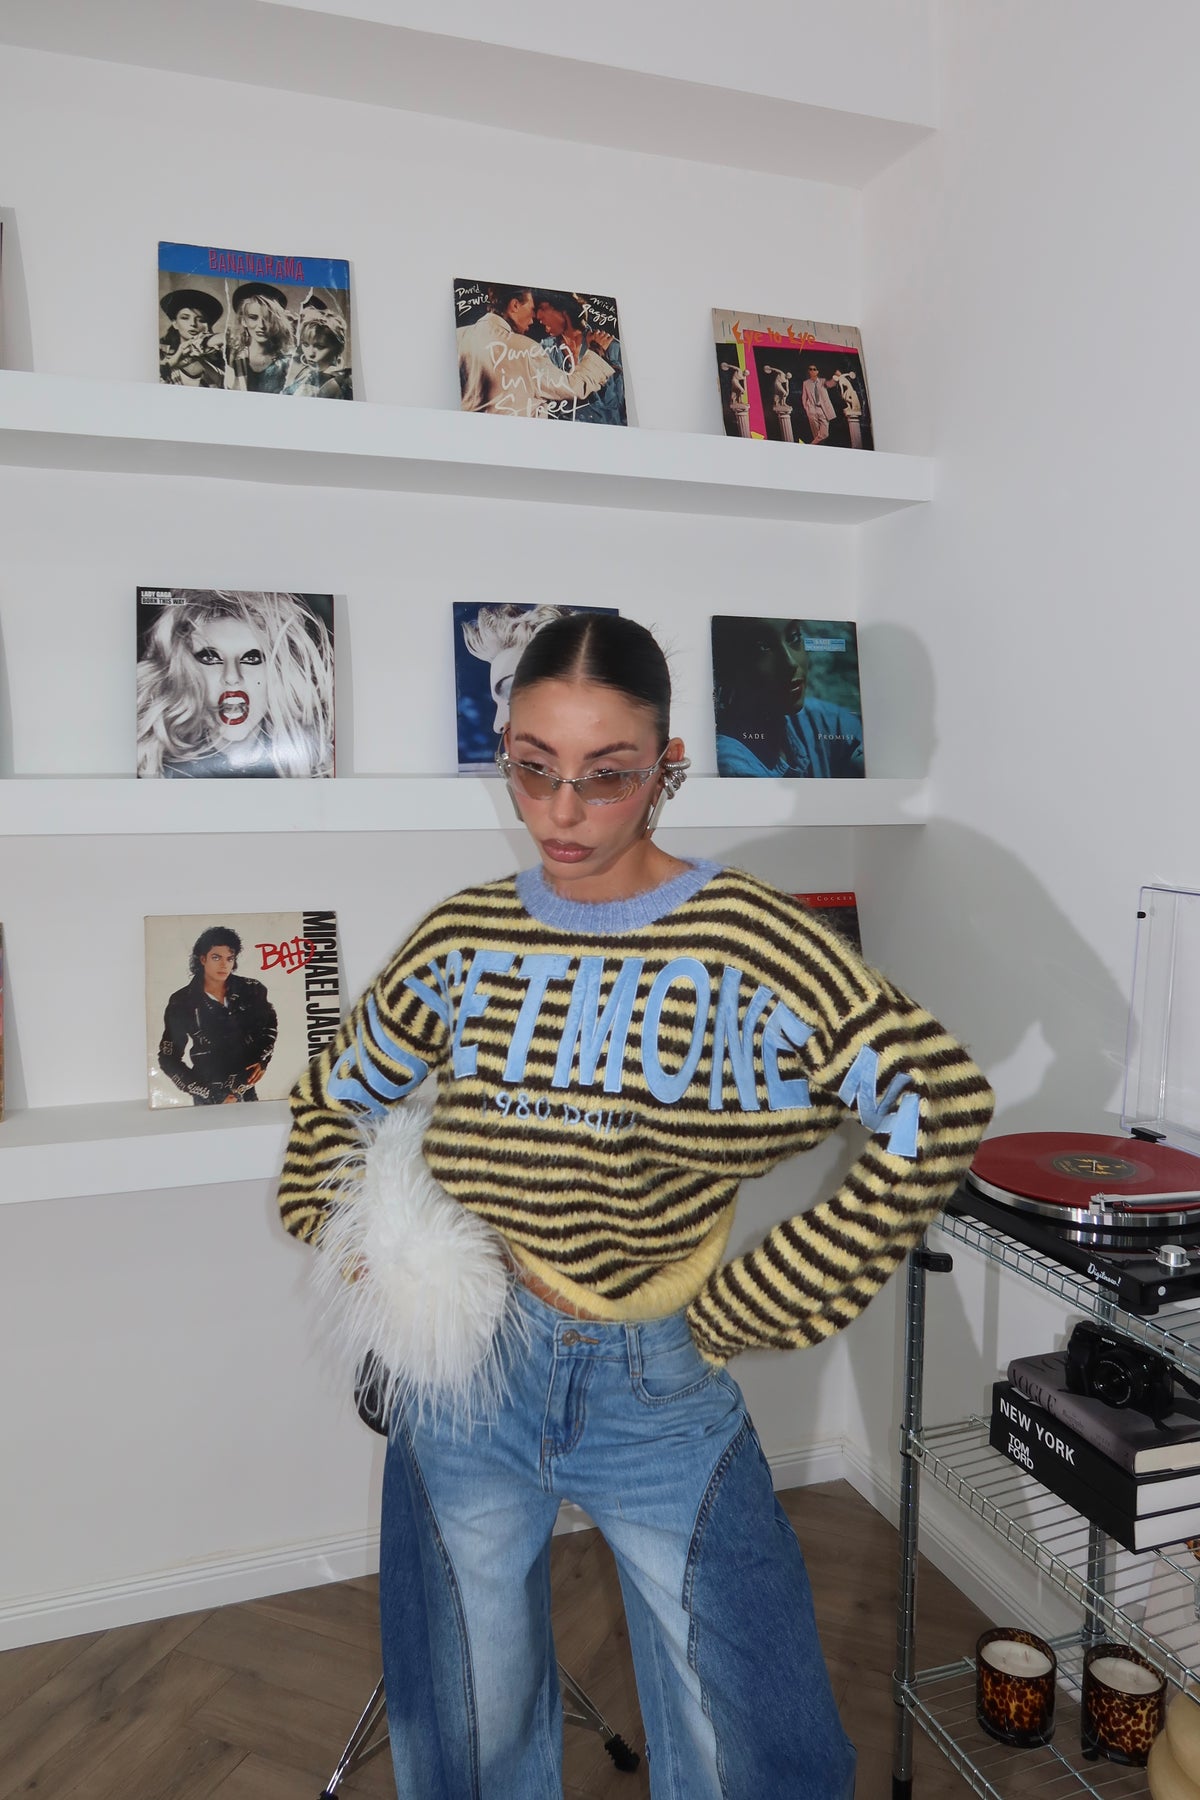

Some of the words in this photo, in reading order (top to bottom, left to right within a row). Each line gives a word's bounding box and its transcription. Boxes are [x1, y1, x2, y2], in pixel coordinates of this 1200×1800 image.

[208, 249, 305, 282] BANANARAMA
[455, 284, 480, 298] David
[456, 294, 490, 317] Bowie
[578, 303, 617, 329] Jagger
[787, 323, 816, 354] Eye
[486, 341, 576, 376] Dancing
[501, 368, 527, 393] in
[531, 369, 575, 398] the
[255, 936, 315, 974] BAD
[302, 911, 339, 1001] MICHAEL
[1000, 1398, 1031, 1432] NEW
[1035, 1422, 1075, 1466] YORK
[1008, 1432, 1030, 1457] TOM
[1008, 1443, 1034, 1470] FORD
